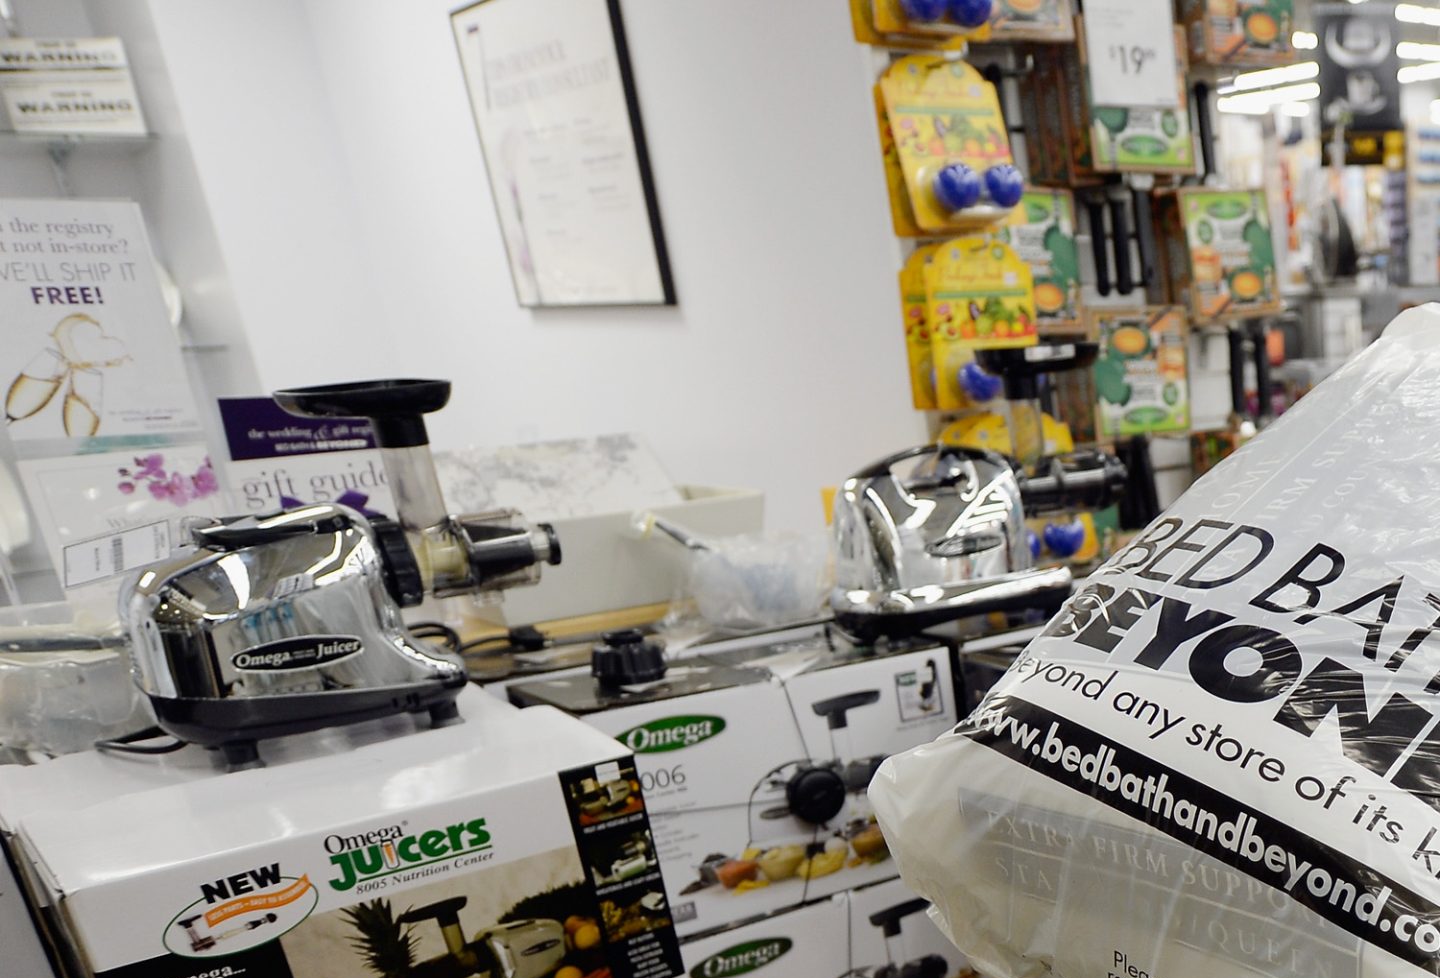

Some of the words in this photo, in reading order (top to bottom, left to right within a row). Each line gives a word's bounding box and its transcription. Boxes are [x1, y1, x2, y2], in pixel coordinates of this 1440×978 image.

[9, 217, 38, 234] the
[47, 218, 114, 238] registry
[12, 239, 45, 253] not
[50, 238, 129, 254] in-store?
[60, 262, 112, 282] SHIP
[119, 262, 136, 281] IT
[30, 286, 104, 305] FREE!
[243, 470, 295, 510] gift
[1098, 516, 1276, 590] BED
[236, 651, 290, 668] Omega
[317, 640, 359, 660] Juicer
[627, 720, 714, 750] Omega
[1009, 649, 1103, 702] Beyond
[1111, 690, 1178, 743] any
[1185, 716, 1287, 786] store
[1294, 771, 1352, 820] of
[1350, 792, 1404, 848] its
[638, 764, 686, 793] 006
[324, 822, 404, 855] Omega
[1092, 834, 1169, 878] FIRM
[200, 863, 281, 904] NEW
[356, 879, 388, 895] 8005
[392, 863, 450, 885] Nutrition
[454, 851, 495, 868] Center
[703, 942, 780, 978] Omega
